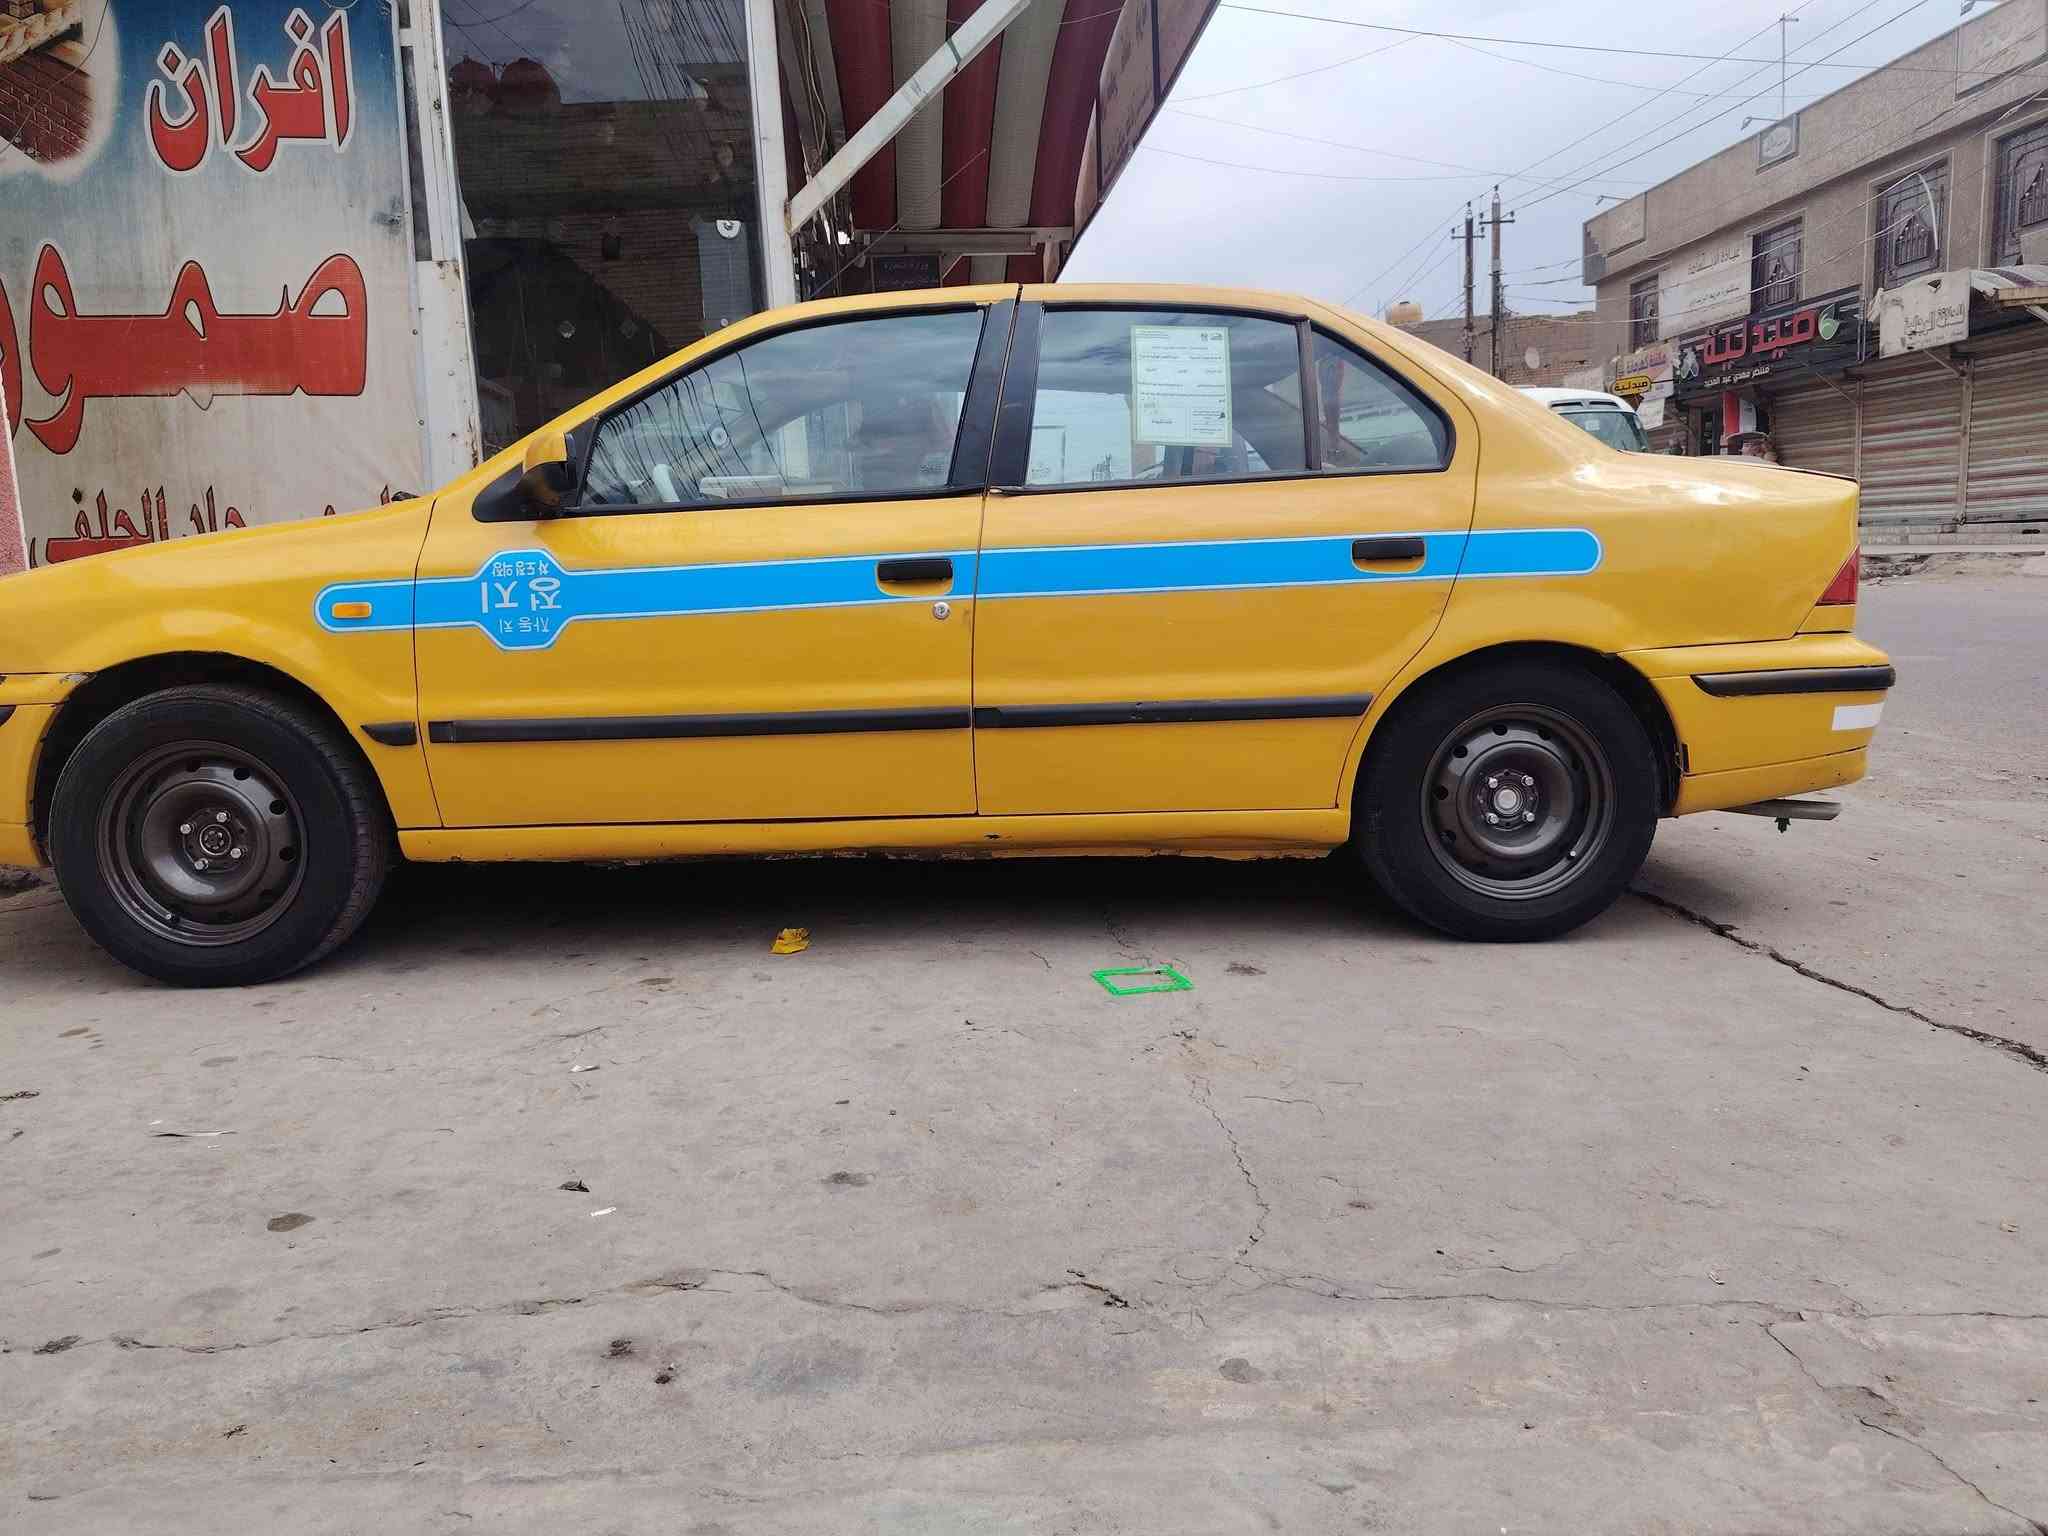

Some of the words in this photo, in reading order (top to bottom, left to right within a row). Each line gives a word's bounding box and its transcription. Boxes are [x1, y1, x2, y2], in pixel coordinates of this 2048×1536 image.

[149, 11, 351, 173] افران
[0, 243, 368, 456] صمو
[1703, 308, 1817, 370] صيدلية
[480, 576, 563, 615] 정지
